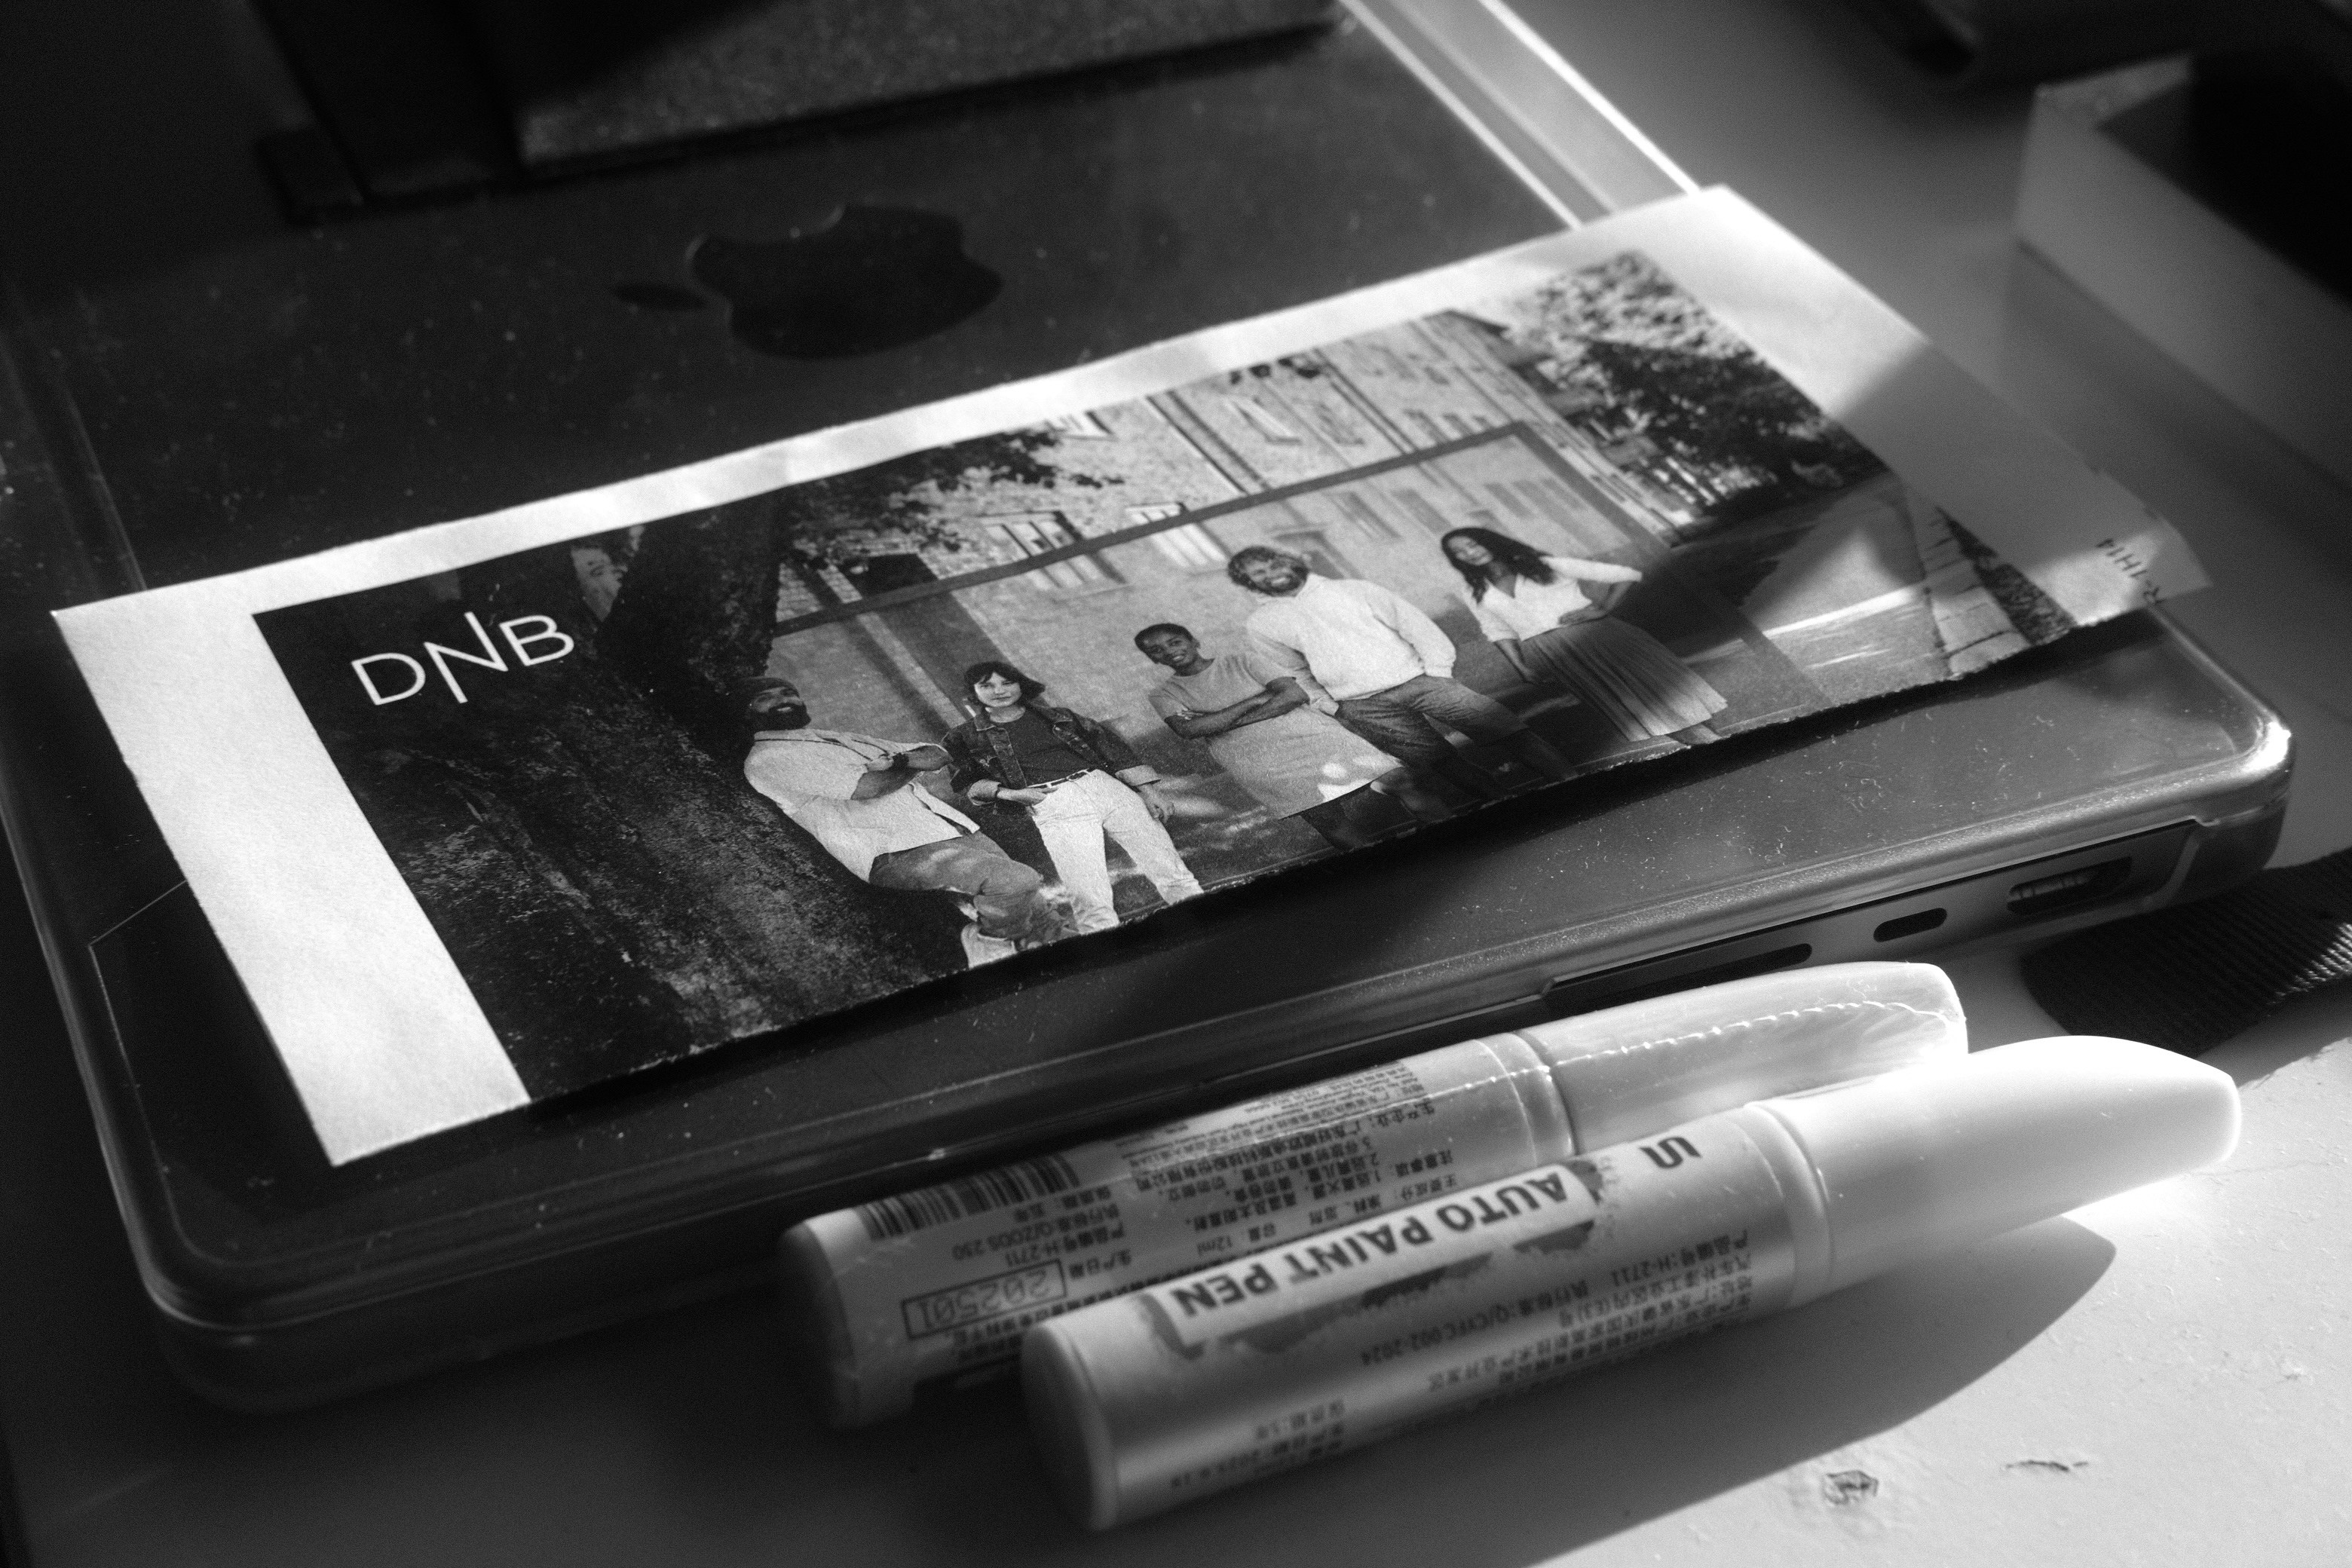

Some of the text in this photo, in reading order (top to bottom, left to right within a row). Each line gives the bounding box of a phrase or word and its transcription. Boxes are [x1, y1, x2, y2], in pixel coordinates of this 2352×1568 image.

[351, 611, 575, 706] DNB
[1436, 1174, 1566, 1232] AUTO
[1285, 1217, 1432, 1282] PAINT
[916, 1267, 1052, 1331] 202501
[1173, 1264, 1277, 1315] PEN
